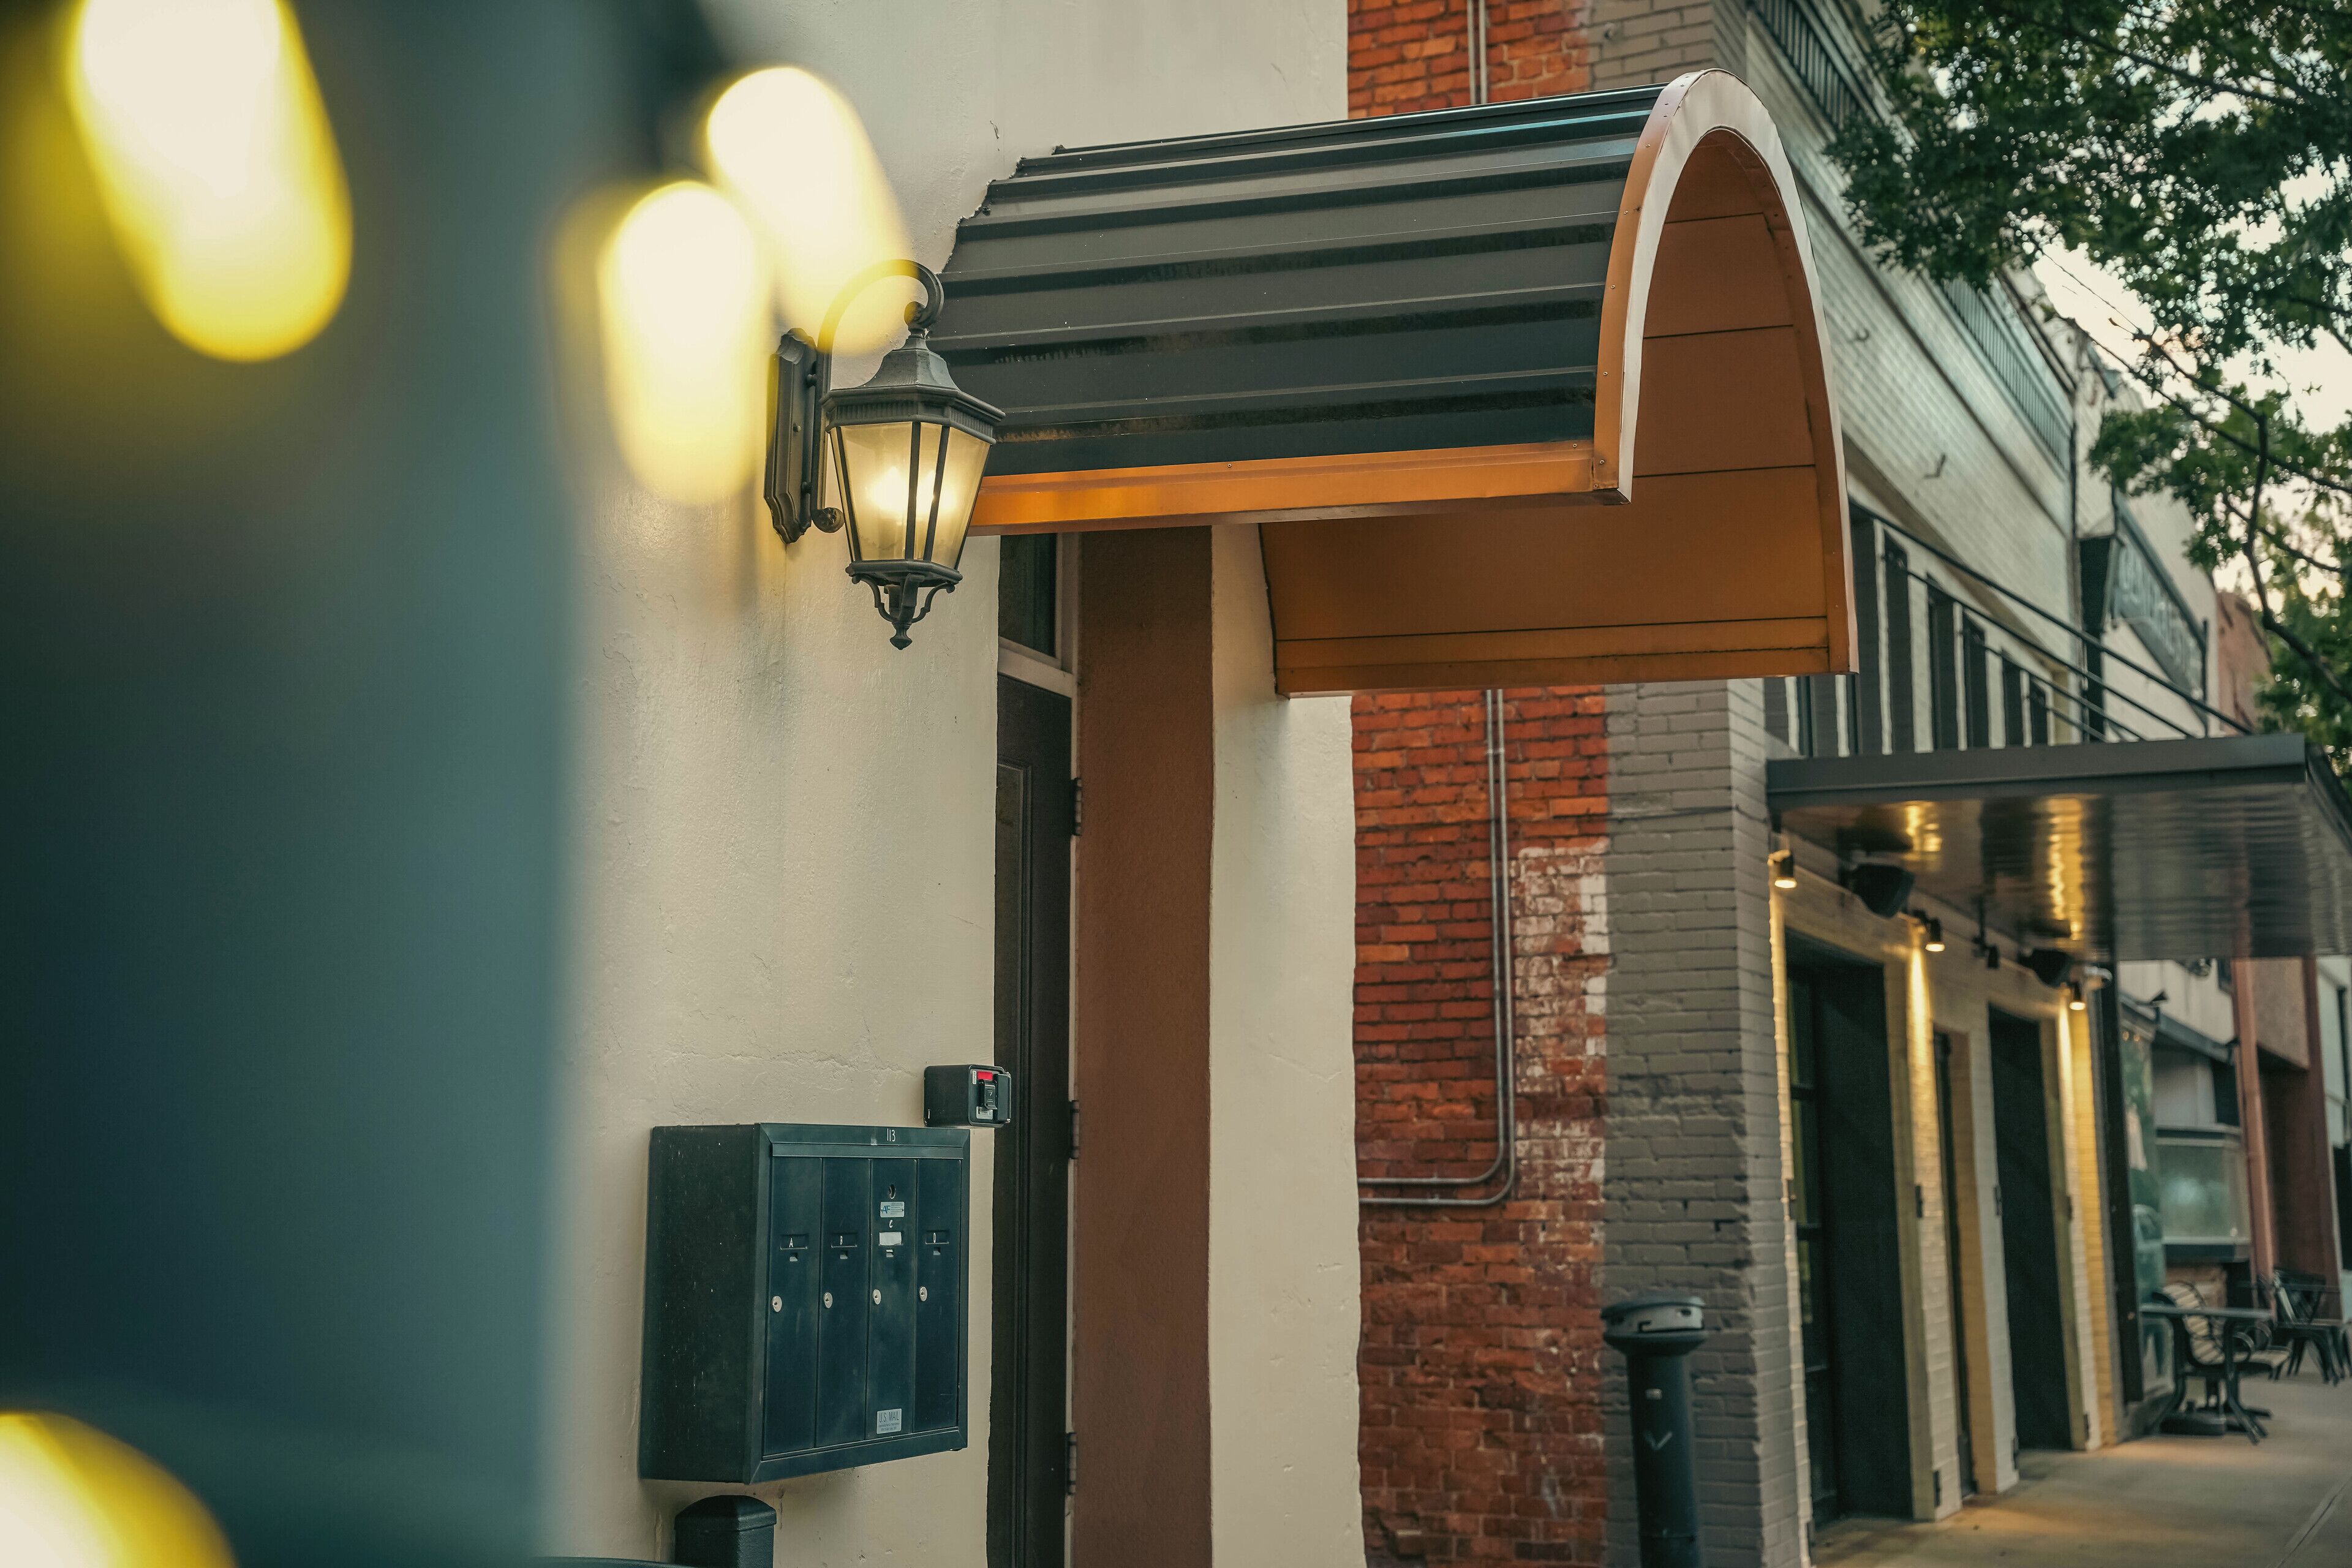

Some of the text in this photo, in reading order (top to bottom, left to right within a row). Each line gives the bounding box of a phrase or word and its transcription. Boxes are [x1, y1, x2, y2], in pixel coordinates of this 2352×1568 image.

[887, 1128, 895, 1142] 113
[881, 1205, 891, 1214] AF
[789, 1237, 794, 1248] A
[840, 1235, 843, 1245] B
[889, 1411, 899, 1422] MAIL
